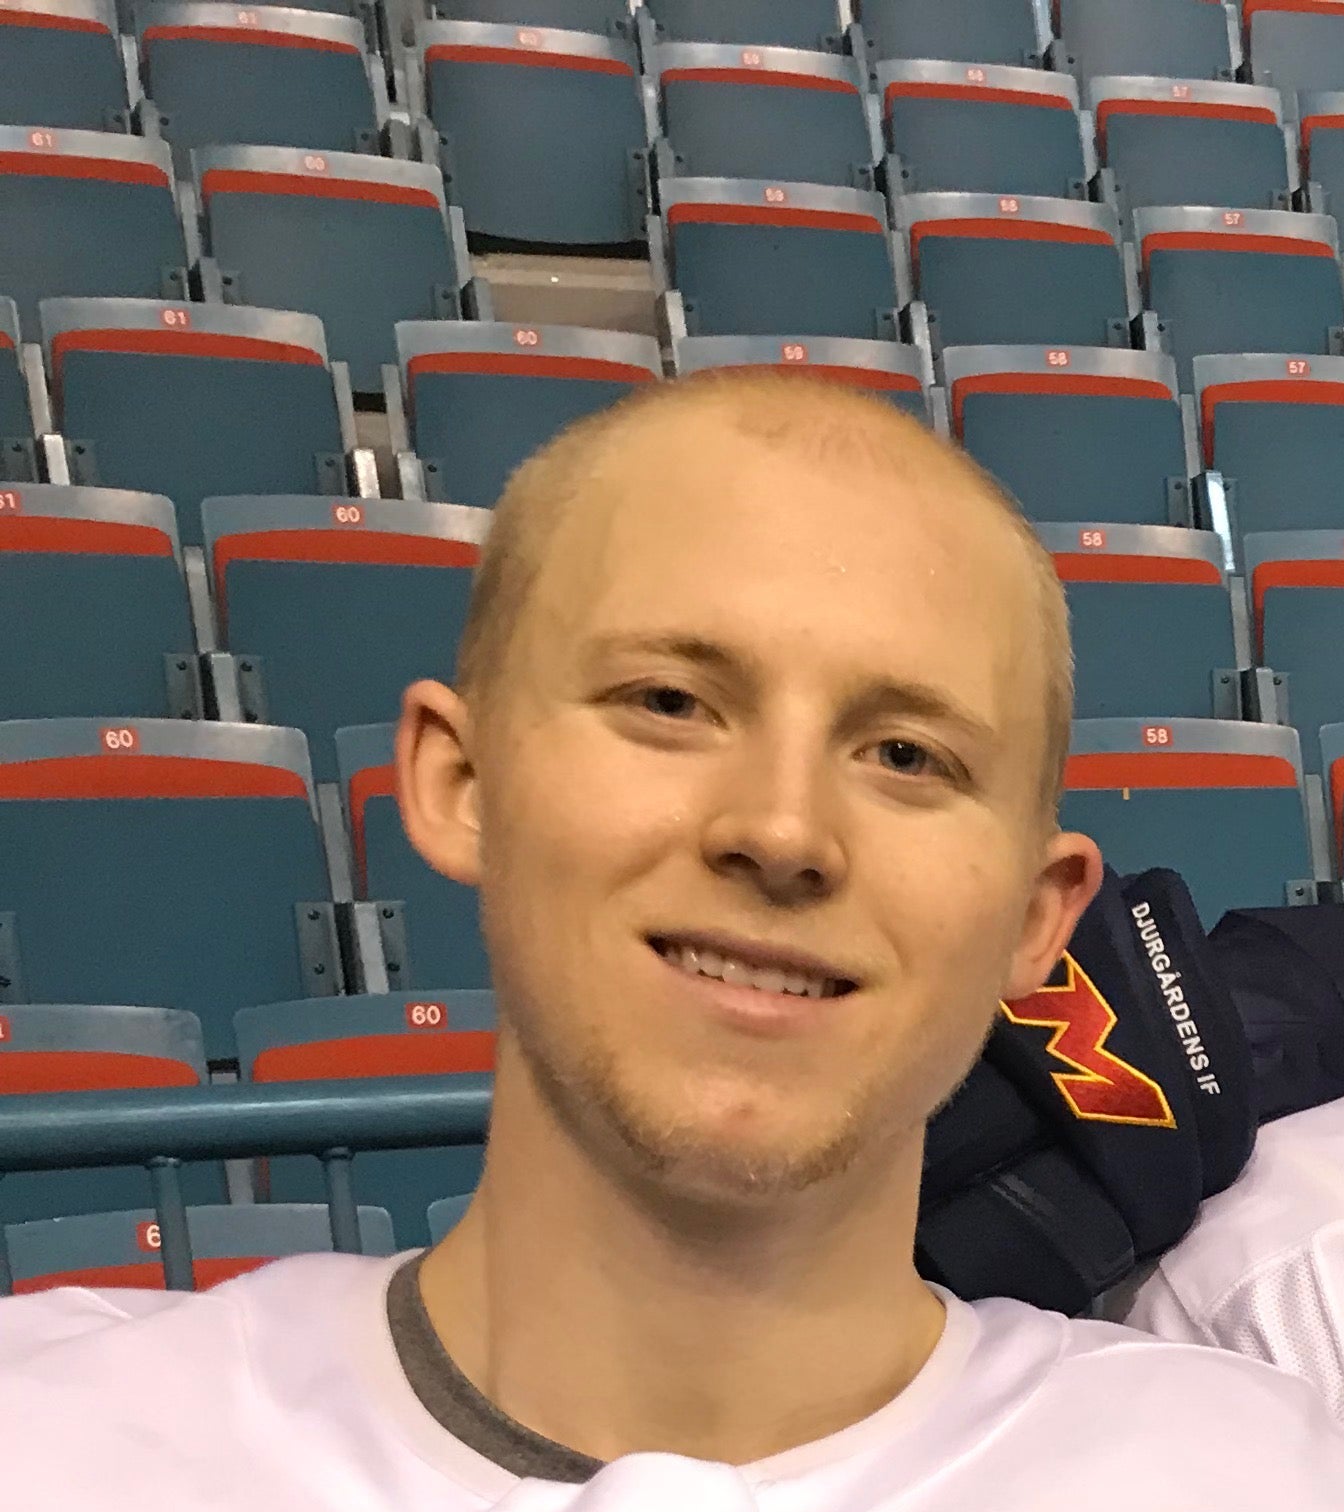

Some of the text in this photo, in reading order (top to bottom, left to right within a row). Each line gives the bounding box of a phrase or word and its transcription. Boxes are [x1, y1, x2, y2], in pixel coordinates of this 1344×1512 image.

[32, 132, 52, 146] 61
[1225, 214, 1240, 225] 57
[164, 310, 186, 325] 61
[517, 330, 537, 344] 60
[1049, 352, 1068, 365] 58
[1289, 361, 1305, 373] 57
[337, 507, 360, 522] 60
[1082, 533, 1101, 545] 58
[106, 729, 133, 748] 60
[1147, 729, 1168, 743] 58
[1131, 901, 1221, 1095] DJURGÅRDENS IF
[412, 1006, 441, 1024] 60
